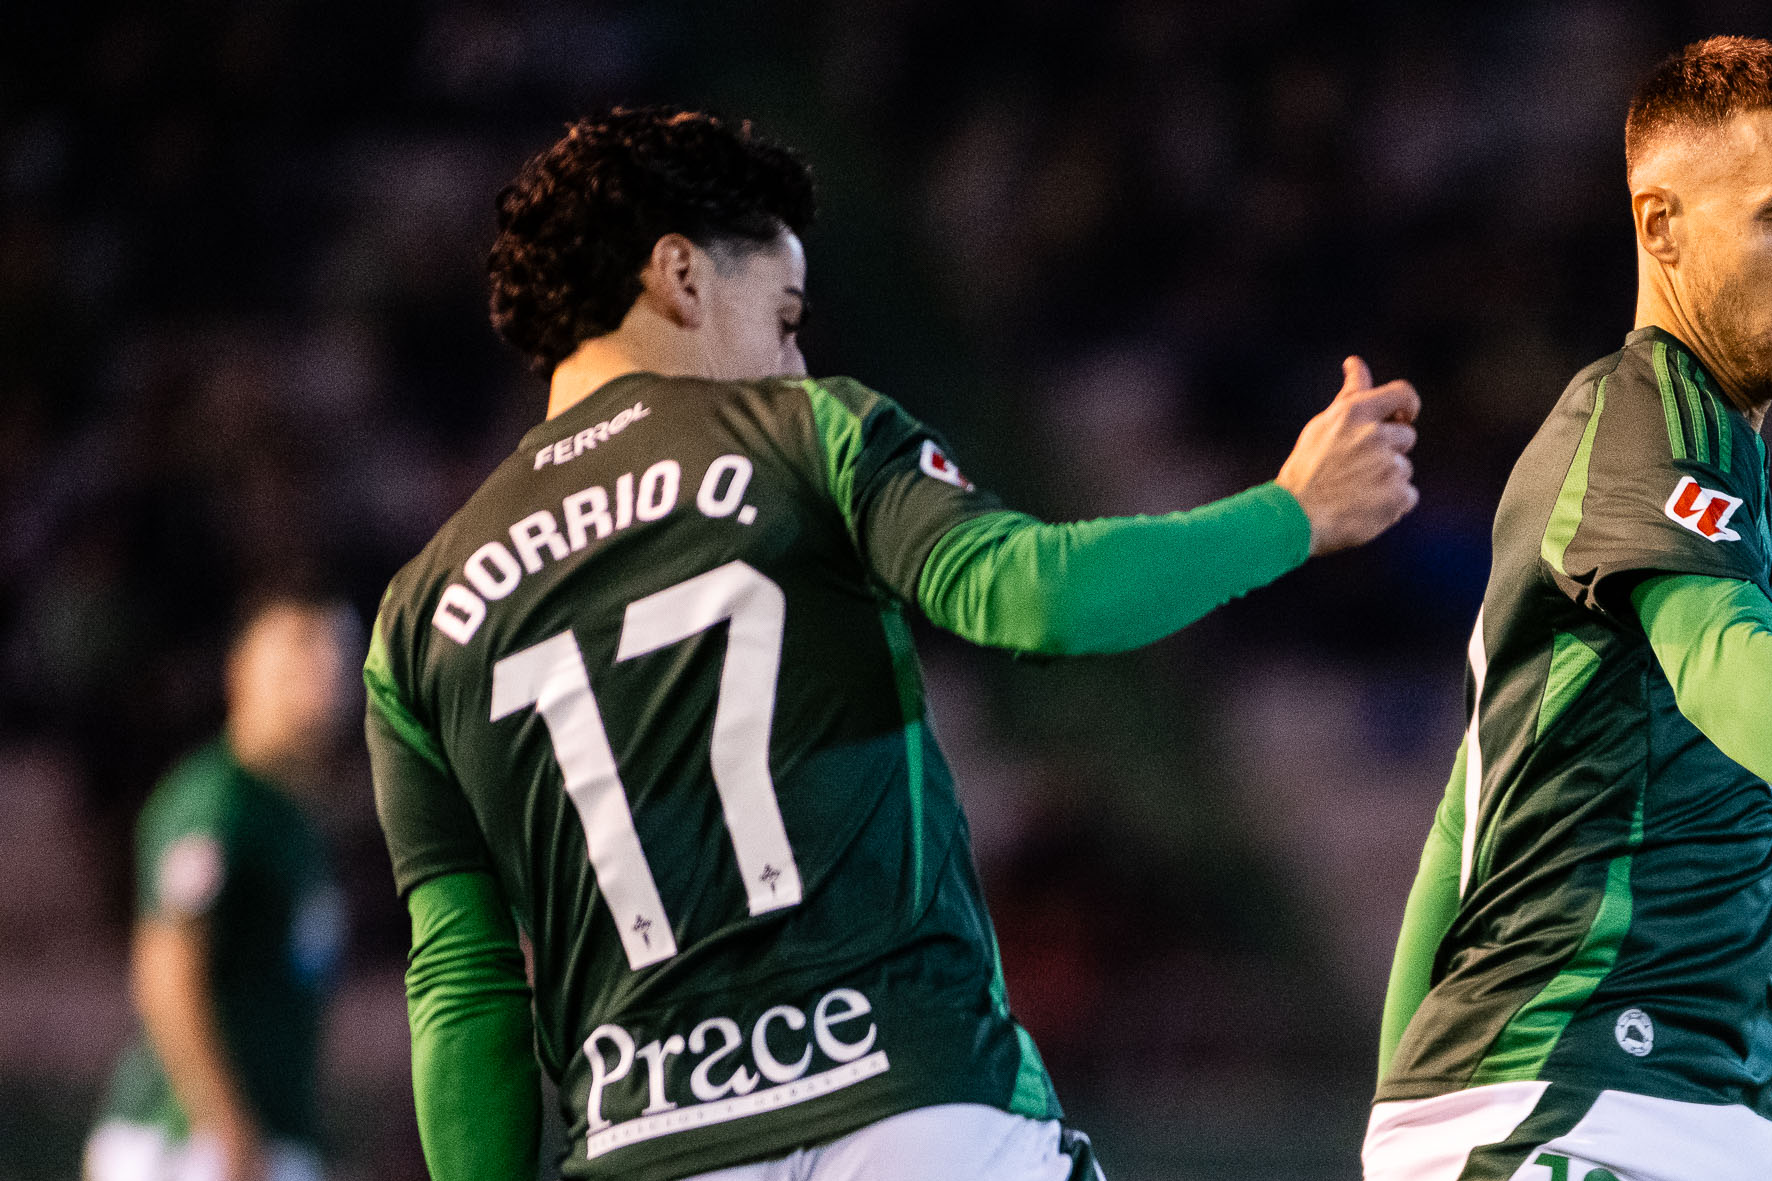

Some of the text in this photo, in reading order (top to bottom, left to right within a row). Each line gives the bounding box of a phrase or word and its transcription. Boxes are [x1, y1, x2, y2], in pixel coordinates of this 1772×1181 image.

[534, 400, 652, 470] FERROL
[432, 453, 758, 645] DORRIO O.
[490, 560, 802, 971] 17
[583, 988, 878, 1140] Prace
